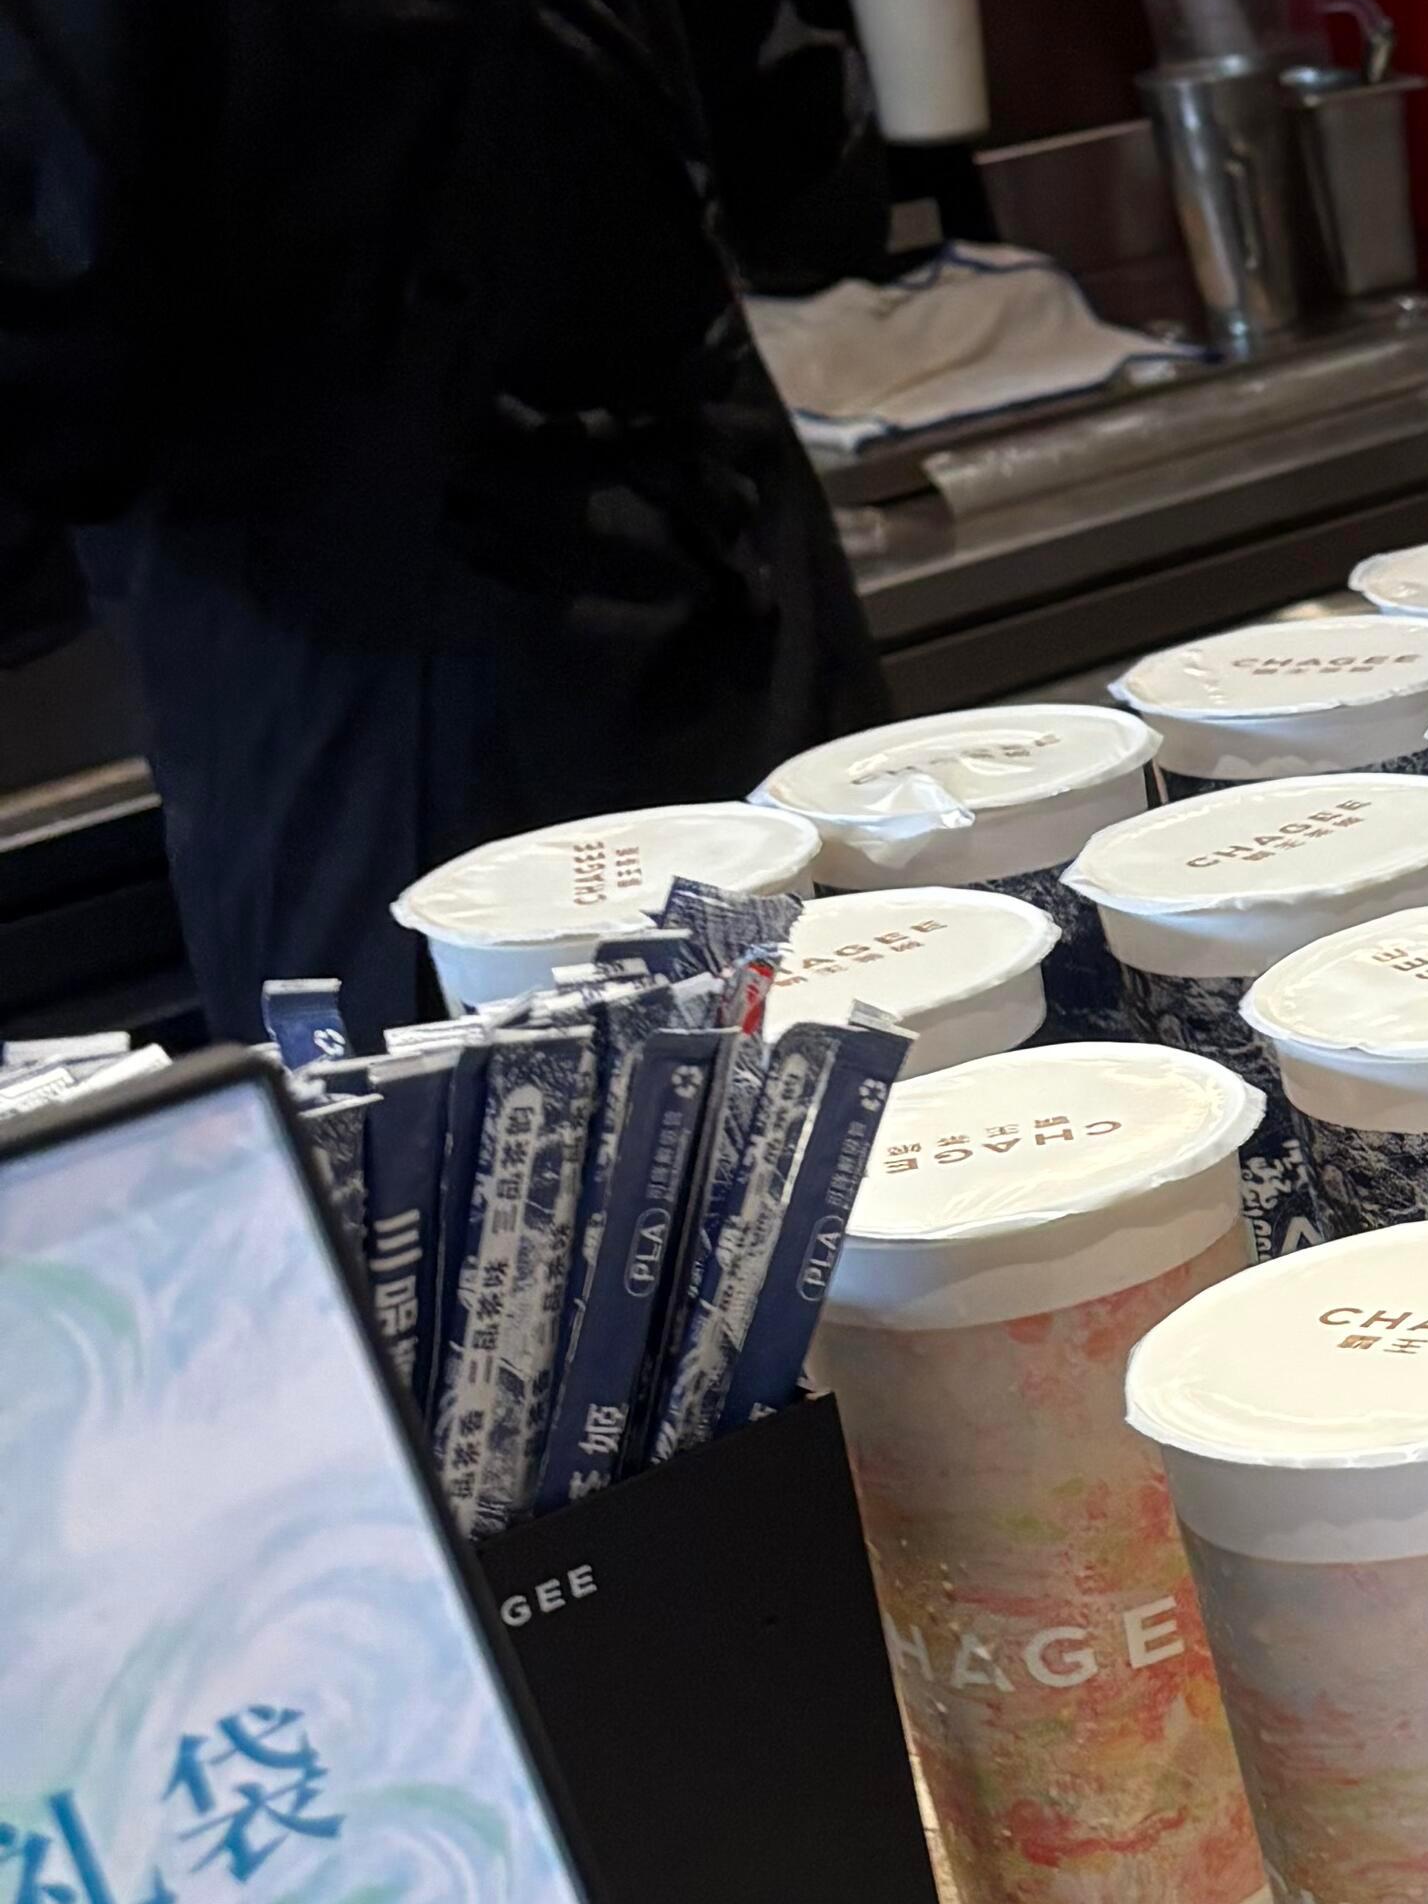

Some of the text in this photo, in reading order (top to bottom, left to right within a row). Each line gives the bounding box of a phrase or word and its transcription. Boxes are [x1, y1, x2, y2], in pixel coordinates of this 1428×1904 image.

[1186, 799, 1373, 868] CHAGEE
[632, 1221, 669, 1283] PLA
[804, 1228, 842, 1288] PLA
[499, 1563, 598, 1628] GEE
